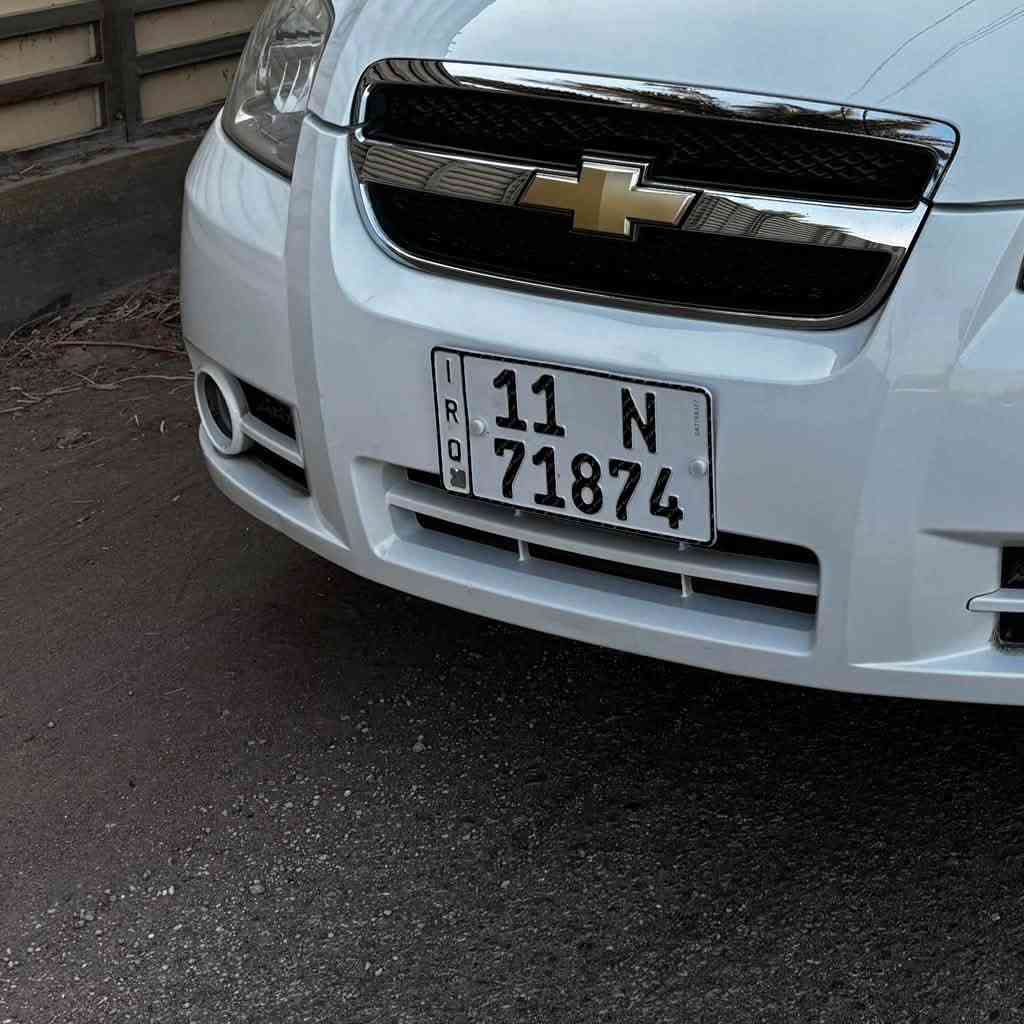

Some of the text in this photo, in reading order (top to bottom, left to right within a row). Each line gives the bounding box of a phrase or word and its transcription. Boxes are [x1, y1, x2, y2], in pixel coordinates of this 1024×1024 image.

[445, 359, 462, 463] IRQ
[494, 369, 566, 437] 11
[621, 388, 657, 453] N
[494, 438, 684, 529] 71874
